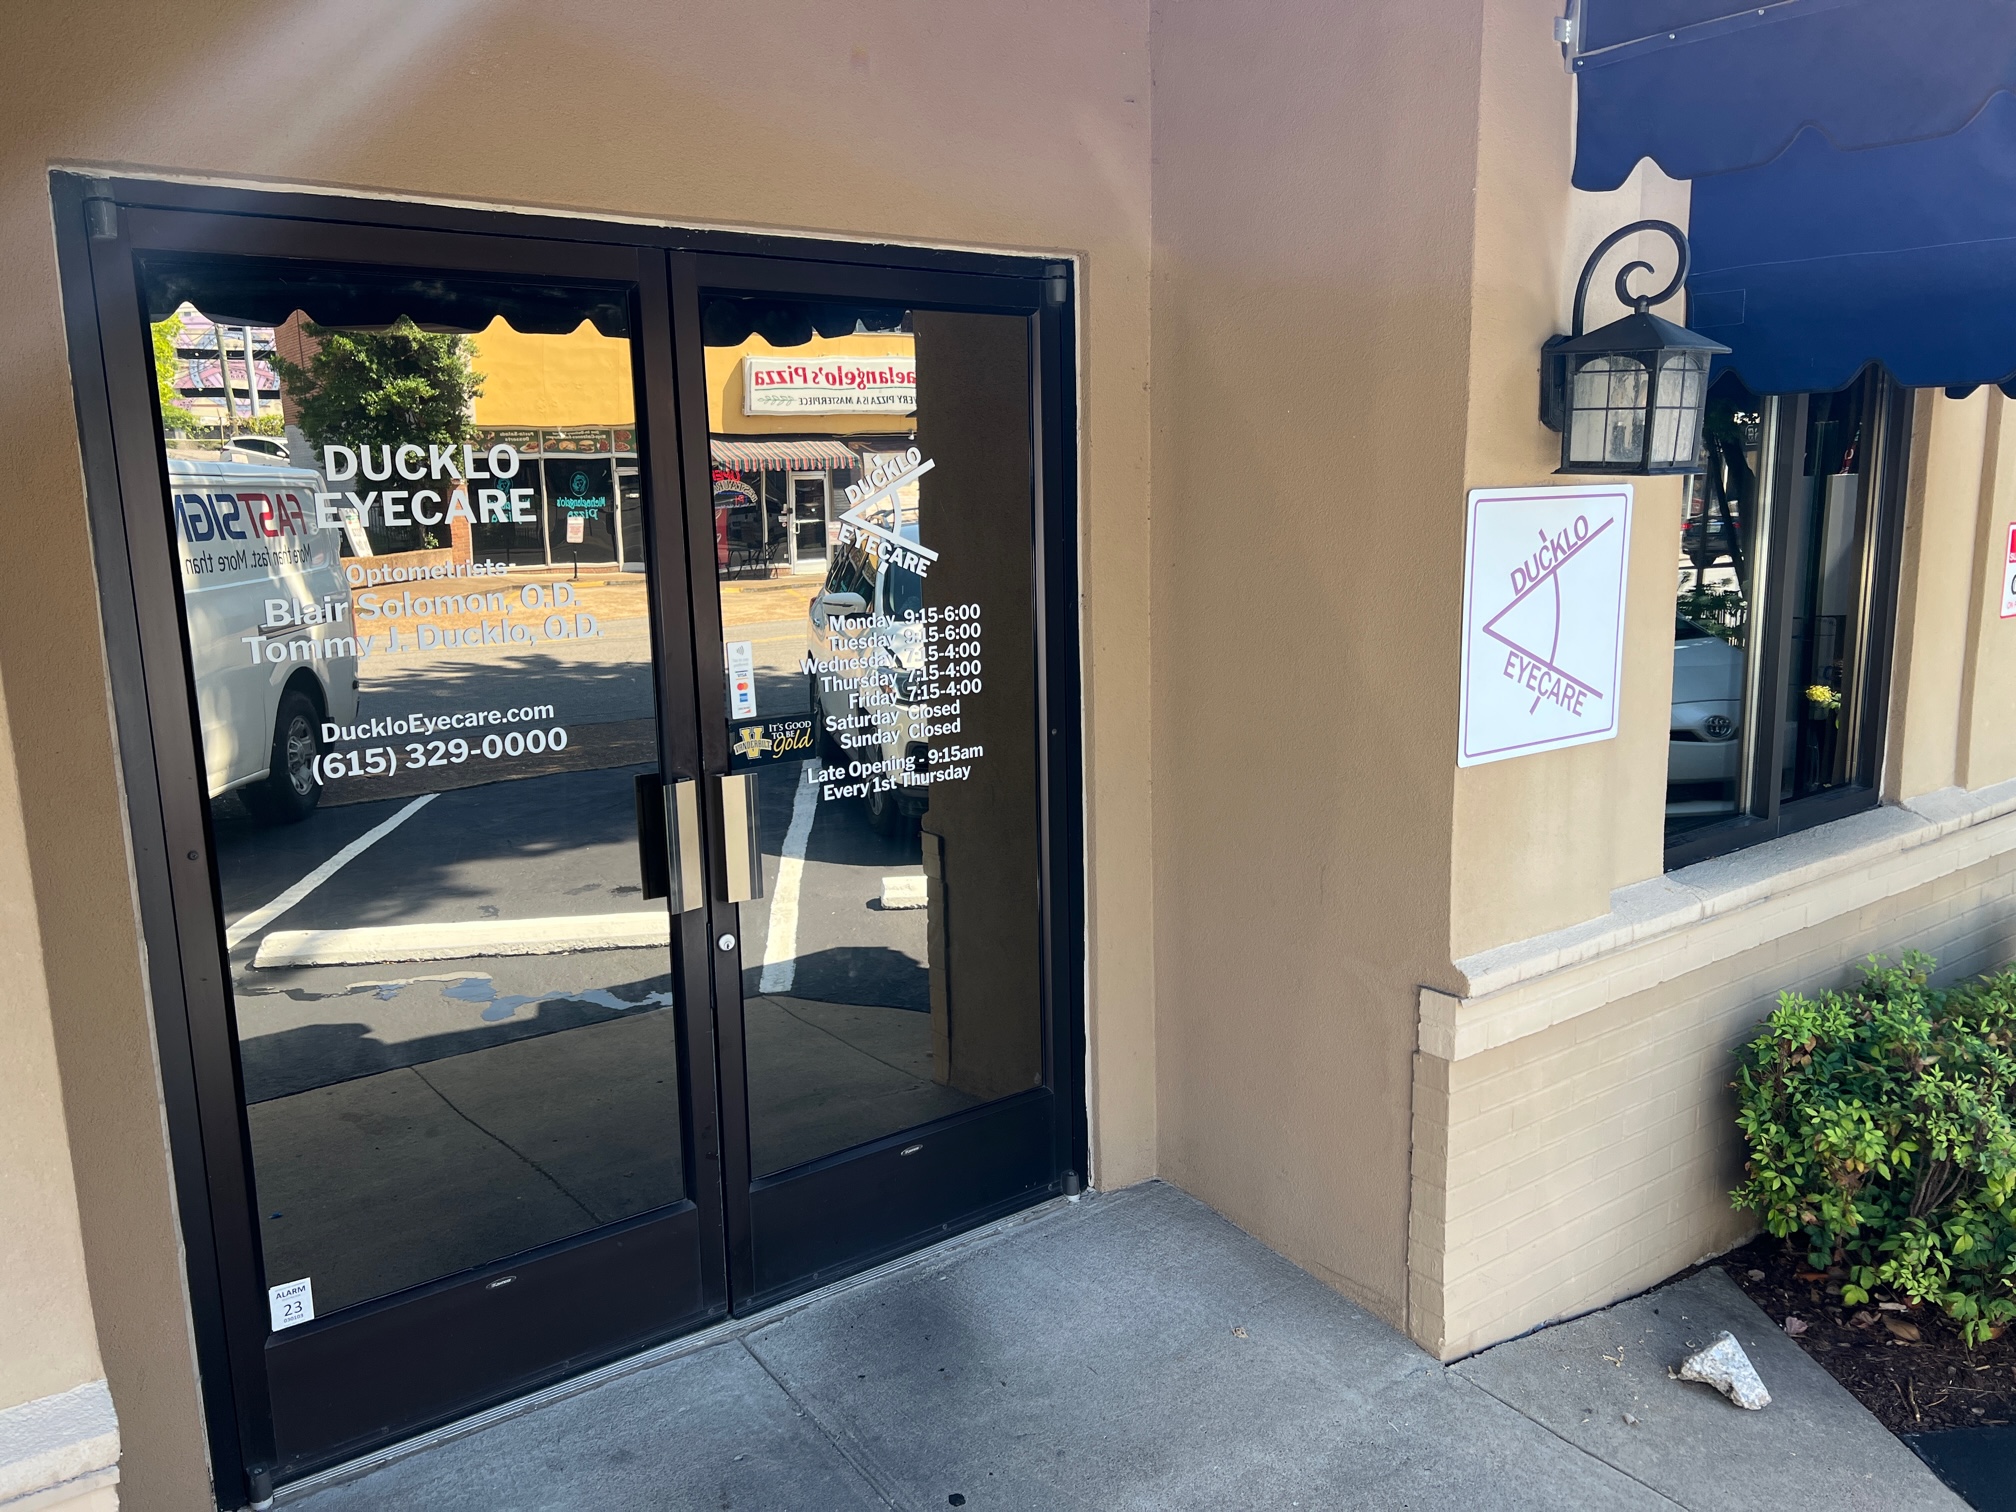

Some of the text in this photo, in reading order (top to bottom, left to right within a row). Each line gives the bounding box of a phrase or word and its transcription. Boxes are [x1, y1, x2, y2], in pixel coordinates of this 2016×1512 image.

[323, 443, 520, 481] DUCKLO
[844, 446, 921, 504] DUCKLO
[314, 488, 537, 529] EYECARE
[838, 522, 931, 578] EYECARE
[1510, 515, 1589, 596] DUCKLO
[264, 582, 581, 627] Blair Solomon, O.D.
[829, 603, 981, 632] Monday 9:15-6:00
[241, 613, 604, 665] Tommy J. Ducklo, O.D.
[827, 622, 981, 652] Tuesday 9:15-6:00
[799, 641, 981, 675] Wednesday 7:15-4:00
[820, 659, 982, 693] Thursday 7:15-4:00
[848, 678, 982, 709] Friday 7:15-4:00
[1503, 650, 1588, 717] EYECARE
[321, 704, 554, 743] DuckloEyecare.com
[768, 720, 812, 732] IT'S GOOD
[825, 699, 960, 732] Saturday Closed
[840, 717, 961, 749] Sunday Closed
[771, 730, 795, 739] TO BE
[312, 727, 568, 786] (615) 329-0000
[807, 767, 846, 785] Late
[848, 754, 916, 779] Opening
[928, 745, 984, 766] 9:15am
[823, 764, 971, 801] Every 1st Thursday
[275, 1285, 306, 1300] ALARM
[283, 1300, 303, 1317] 23
